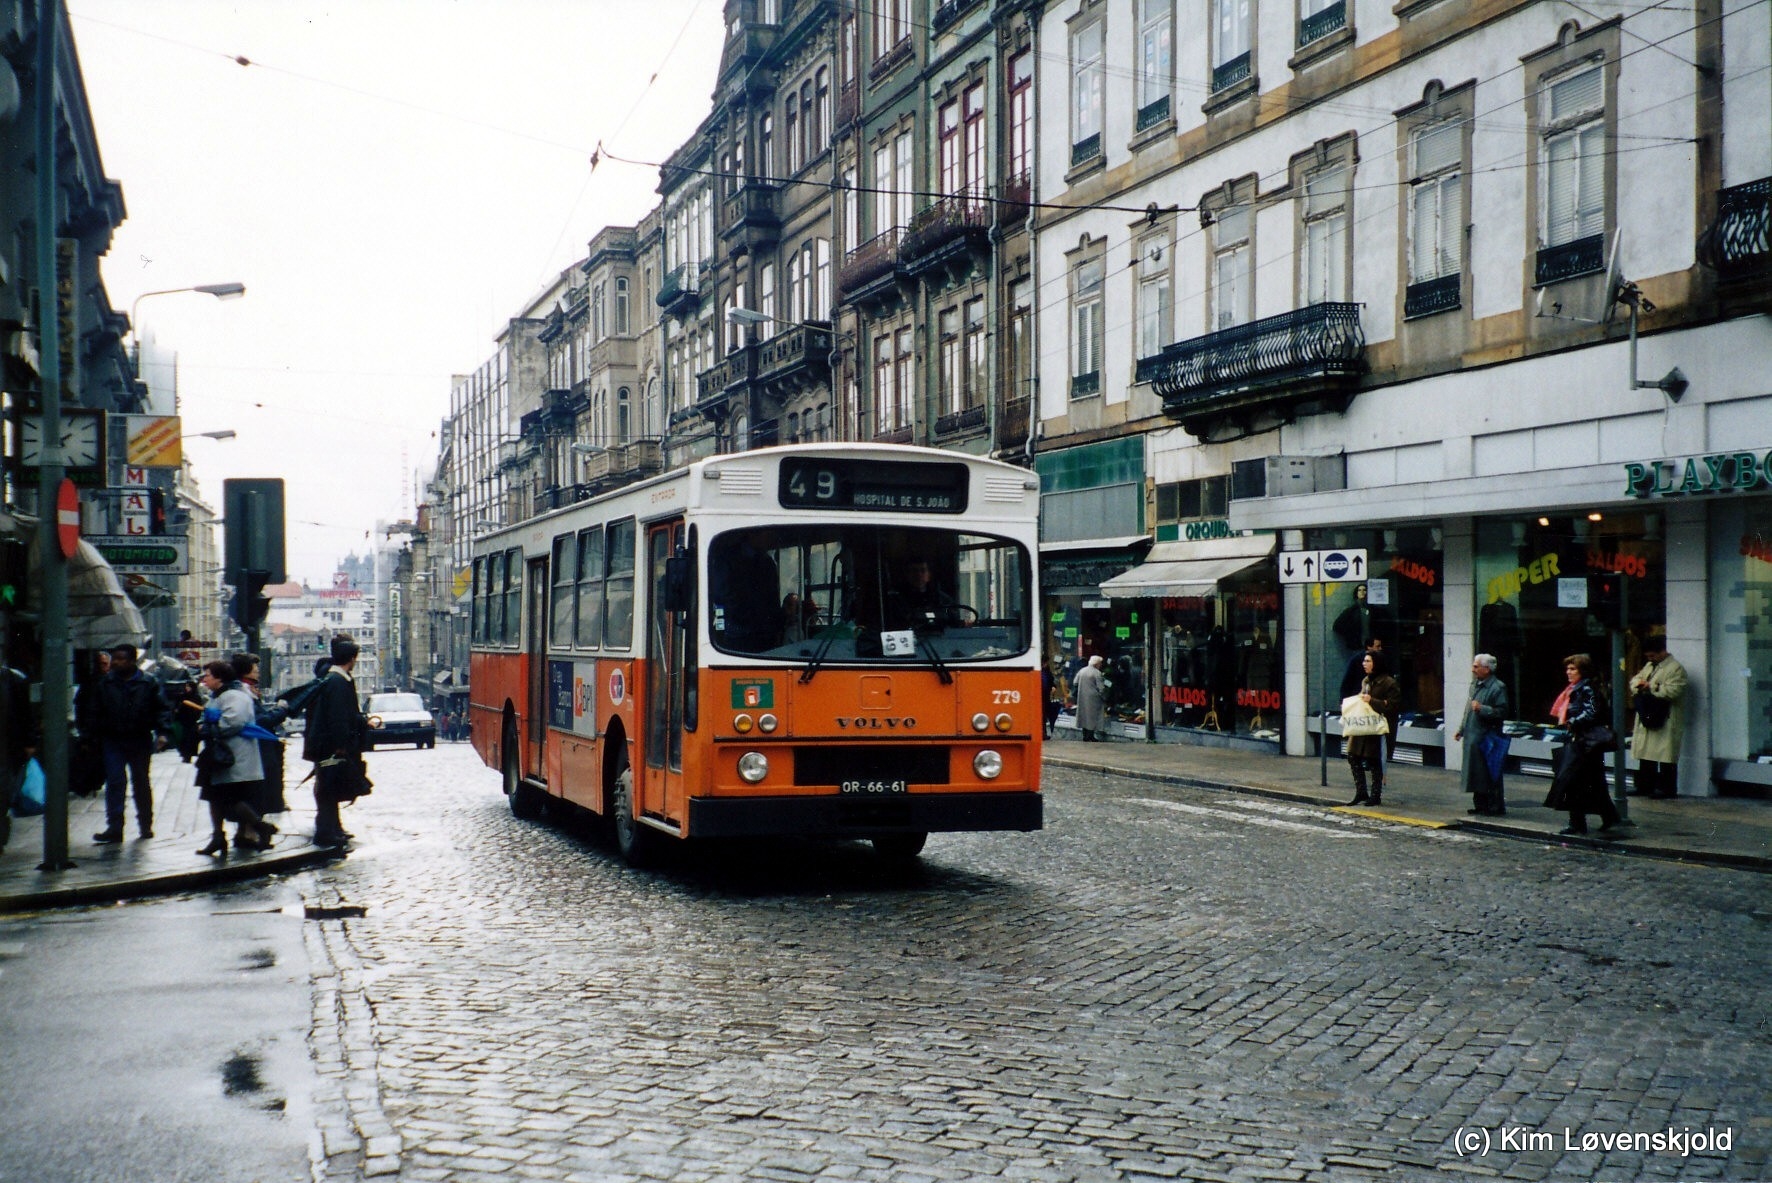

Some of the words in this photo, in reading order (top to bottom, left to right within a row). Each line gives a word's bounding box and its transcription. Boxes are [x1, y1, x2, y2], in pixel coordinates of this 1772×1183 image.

[789, 470, 835, 499] 49
[853, 493, 896, 506] HOSPITAL
[900, 496, 912, 507] DE
[1390, 556, 1436, 587] SALDOS
[1586, 551, 1647, 578] SALDOS
[1486, 552, 1561, 605] SUPER
[991, 690, 1022, 704] 779
[1163, 685, 1207, 706] SALDOS
[1237, 687, 1281, 710] SALDO
[835, 717, 917, 730] VOLVO
[842, 781, 906, 793] OR-66-61
